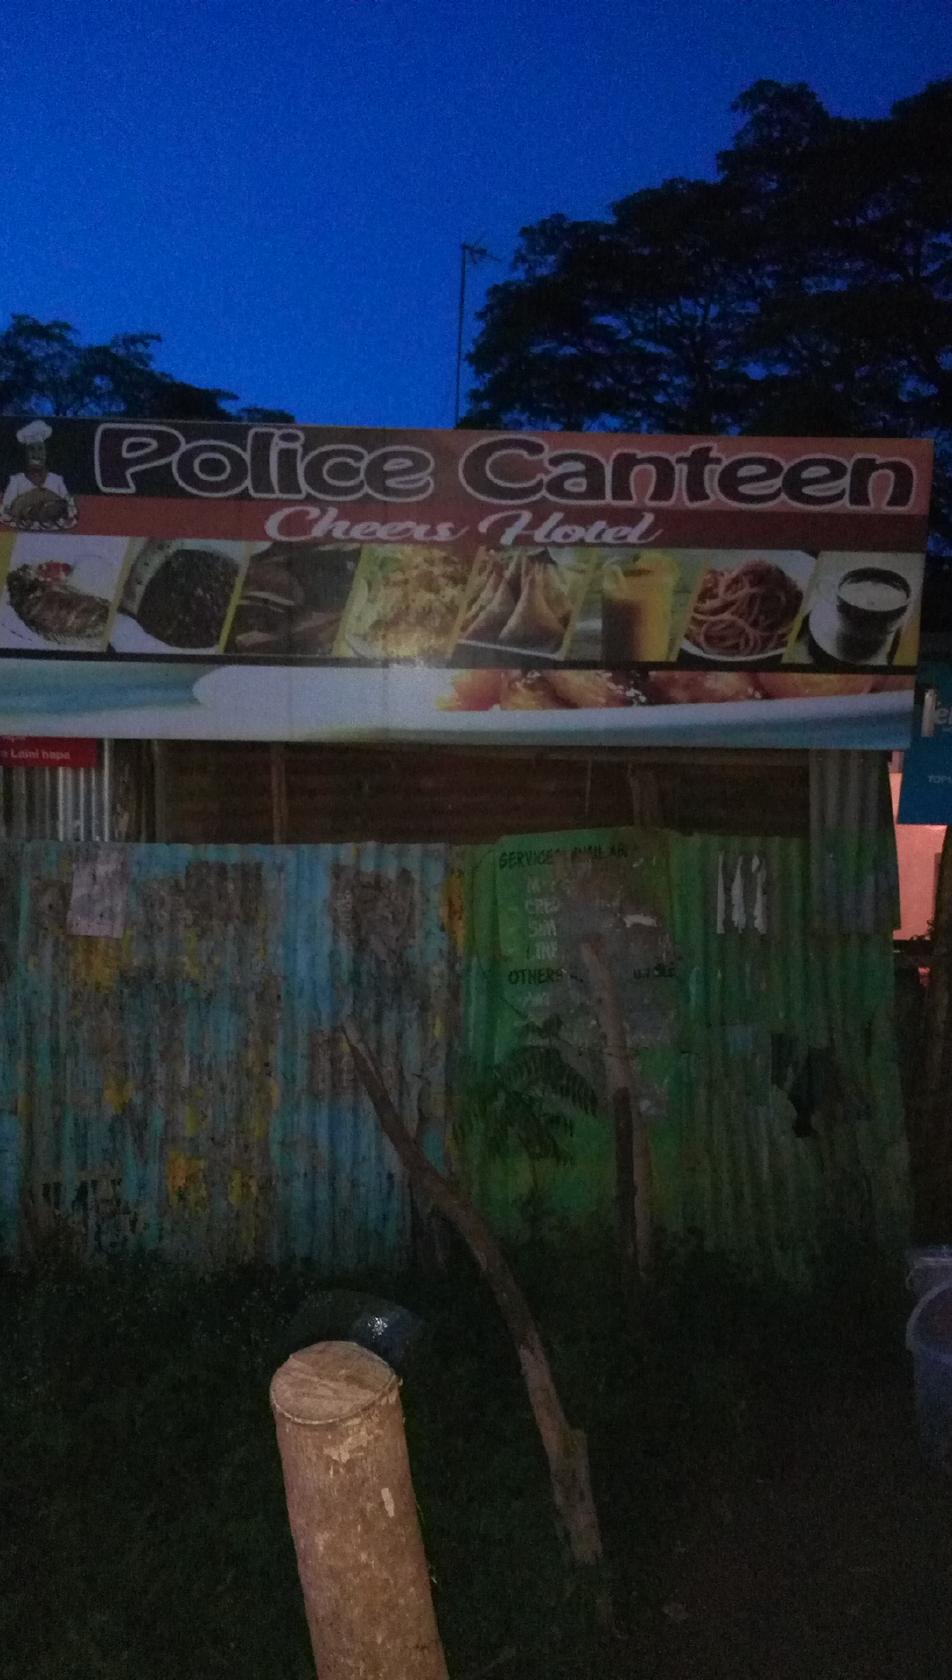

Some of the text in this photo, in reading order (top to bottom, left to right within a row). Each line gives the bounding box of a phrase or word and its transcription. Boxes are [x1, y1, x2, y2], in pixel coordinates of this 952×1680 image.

[95, 422, 917, 511] Police Canteen
[264, 505, 664, 546] Cheers Hotel
